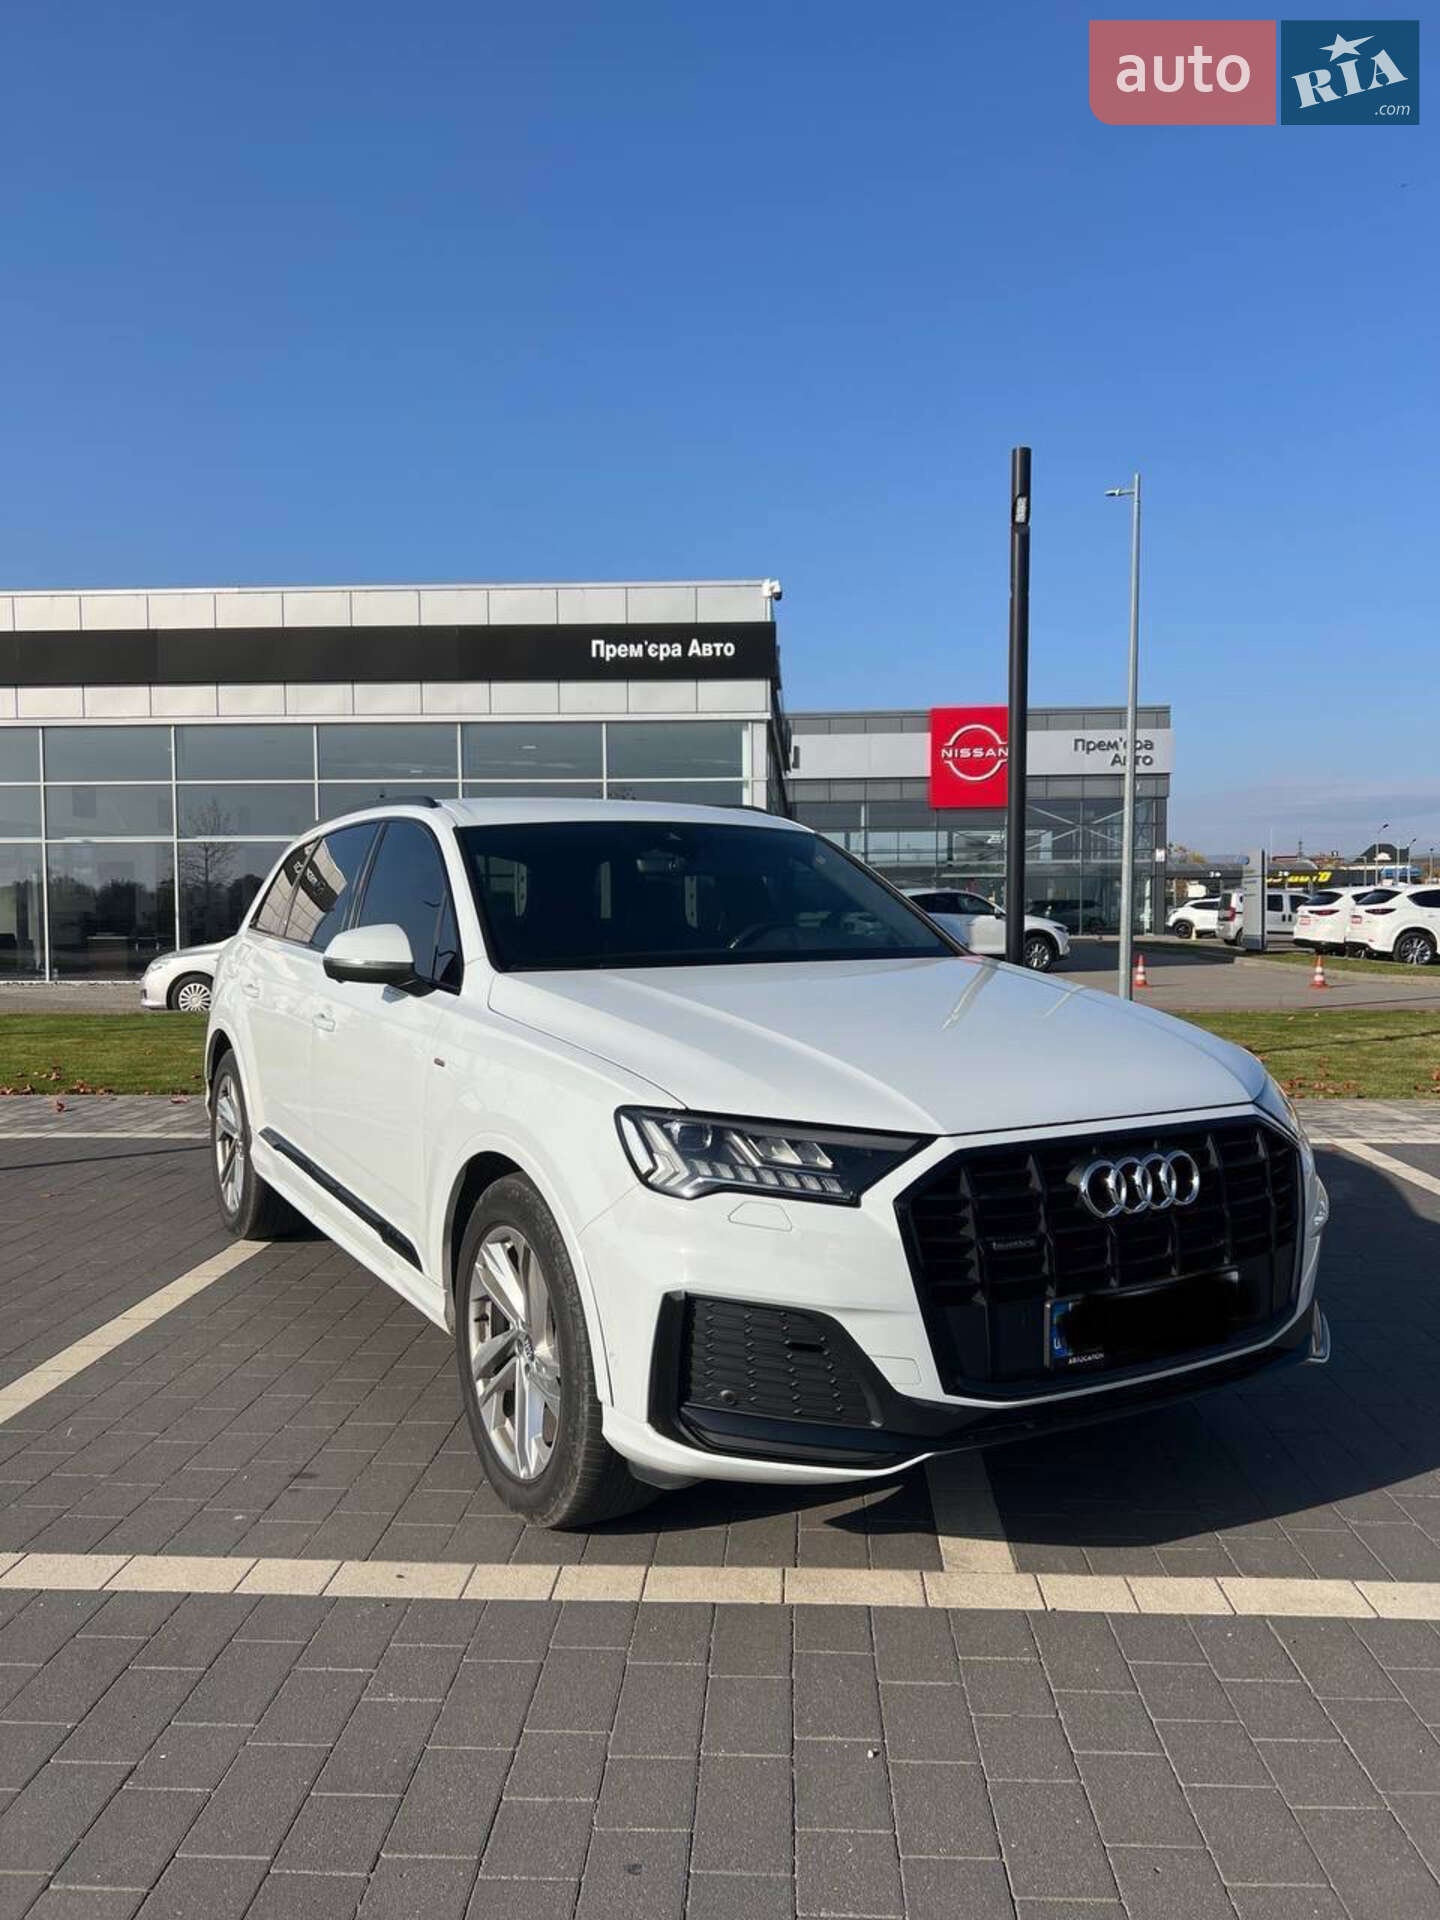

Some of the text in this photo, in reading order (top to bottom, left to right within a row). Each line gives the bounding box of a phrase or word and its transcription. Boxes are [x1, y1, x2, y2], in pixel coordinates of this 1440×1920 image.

[591, 638, 736, 661] Прем'єра Авто
[941, 747, 1009, 759] NISSAN
[1110, 753, 1154, 767] Ато
